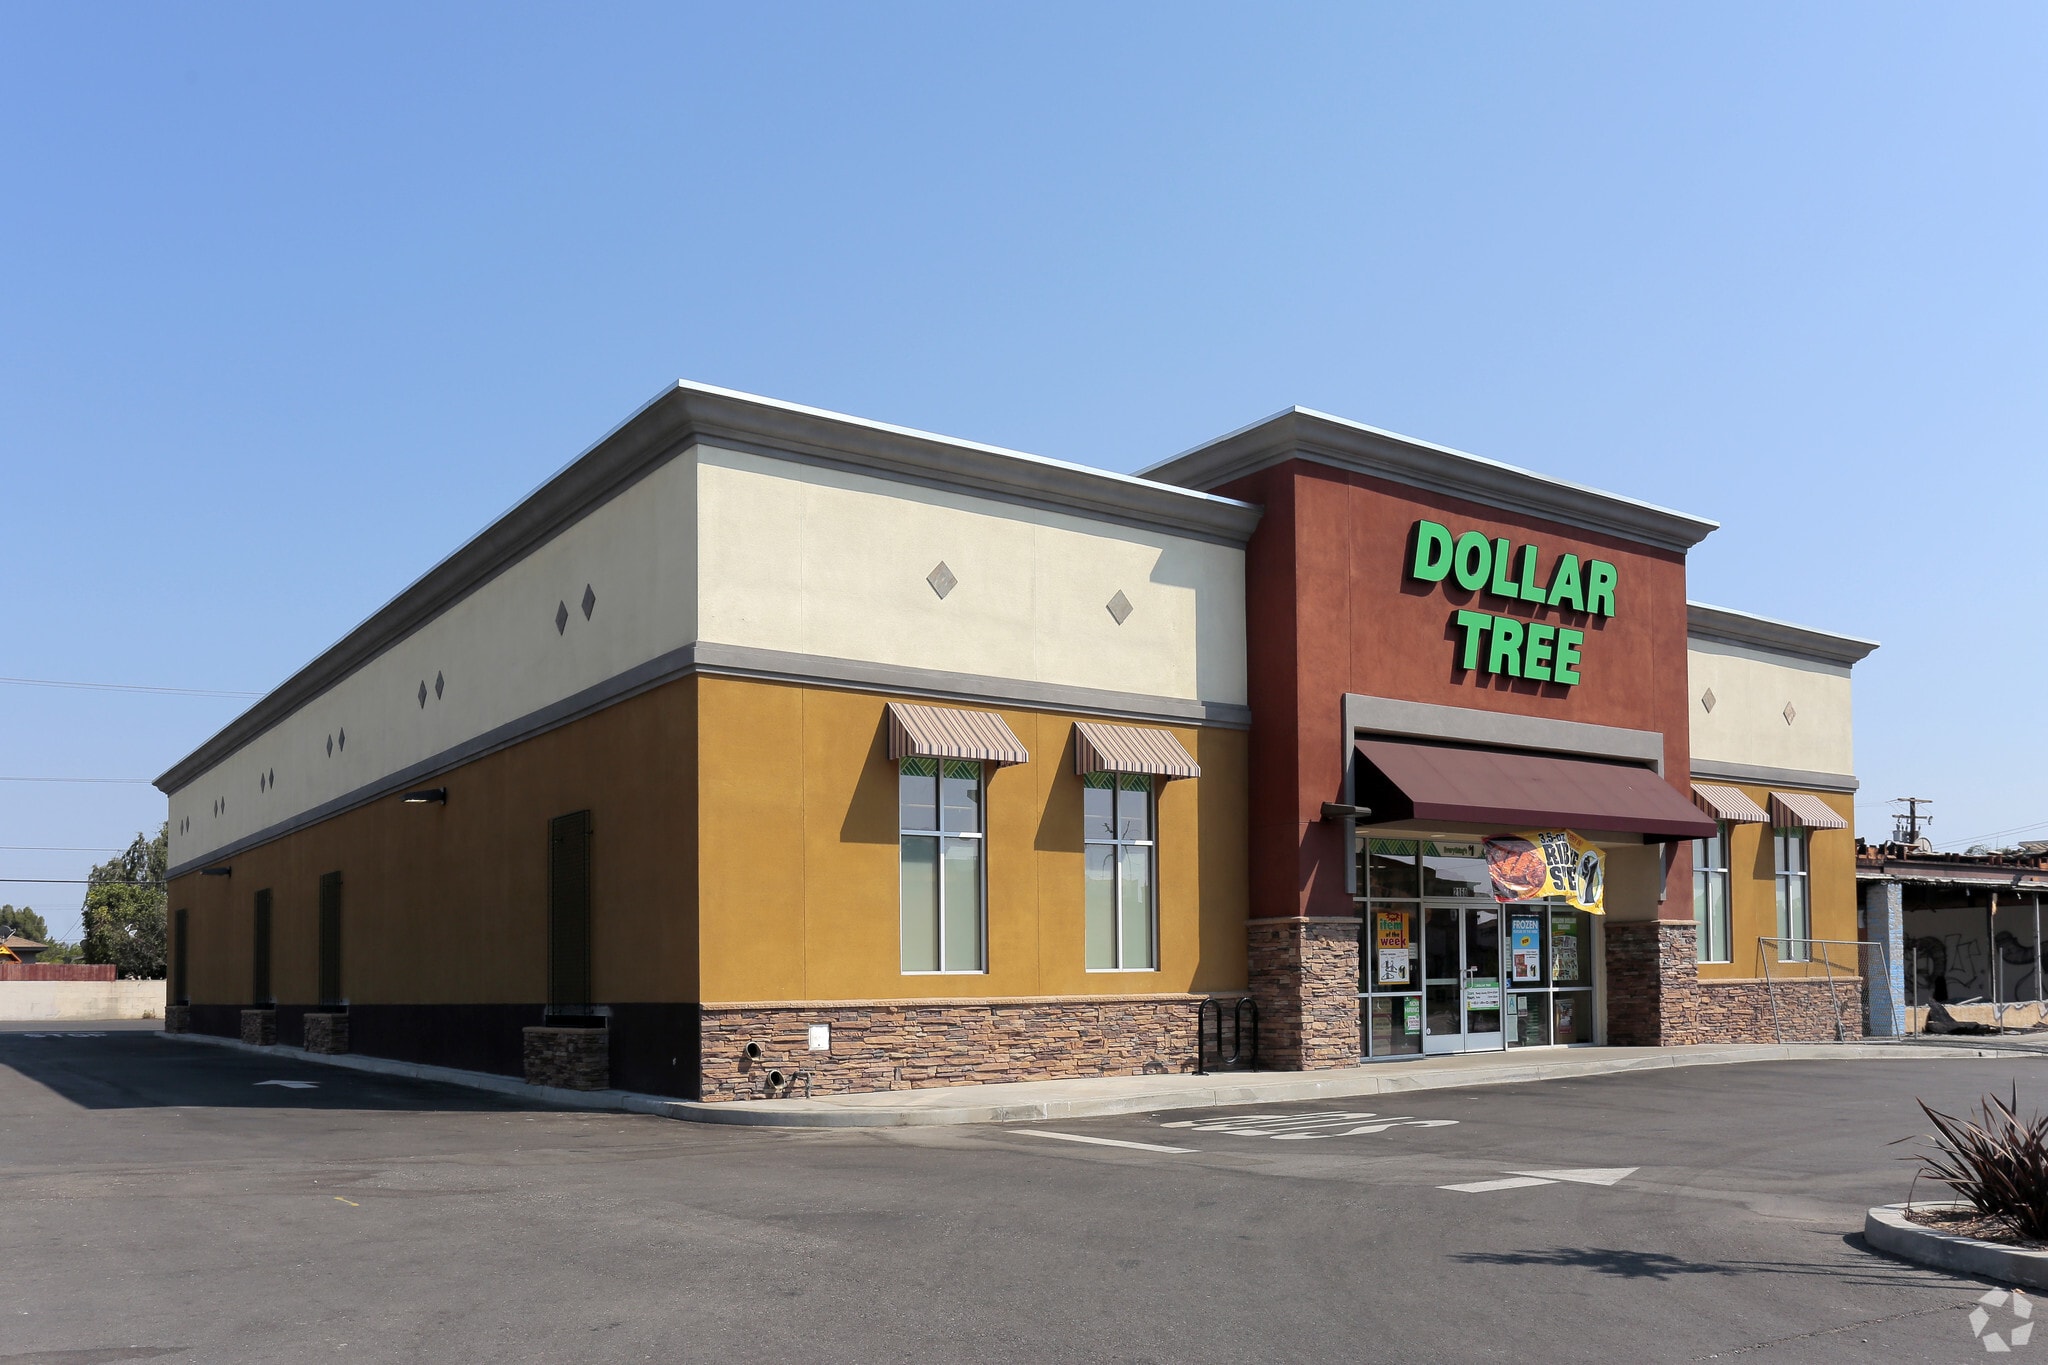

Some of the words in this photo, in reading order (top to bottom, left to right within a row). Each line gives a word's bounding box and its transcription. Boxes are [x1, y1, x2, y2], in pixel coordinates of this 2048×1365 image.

[1412, 519, 1619, 618] DOLLAR
[1456, 609, 1584, 686] TREE
[1380, 919, 1403, 930] item
[1512, 919, 1538, 930] FROZEN
[1380, 938, 1406, 946] week
[1160, 1110, 1460, 1140] STOP
